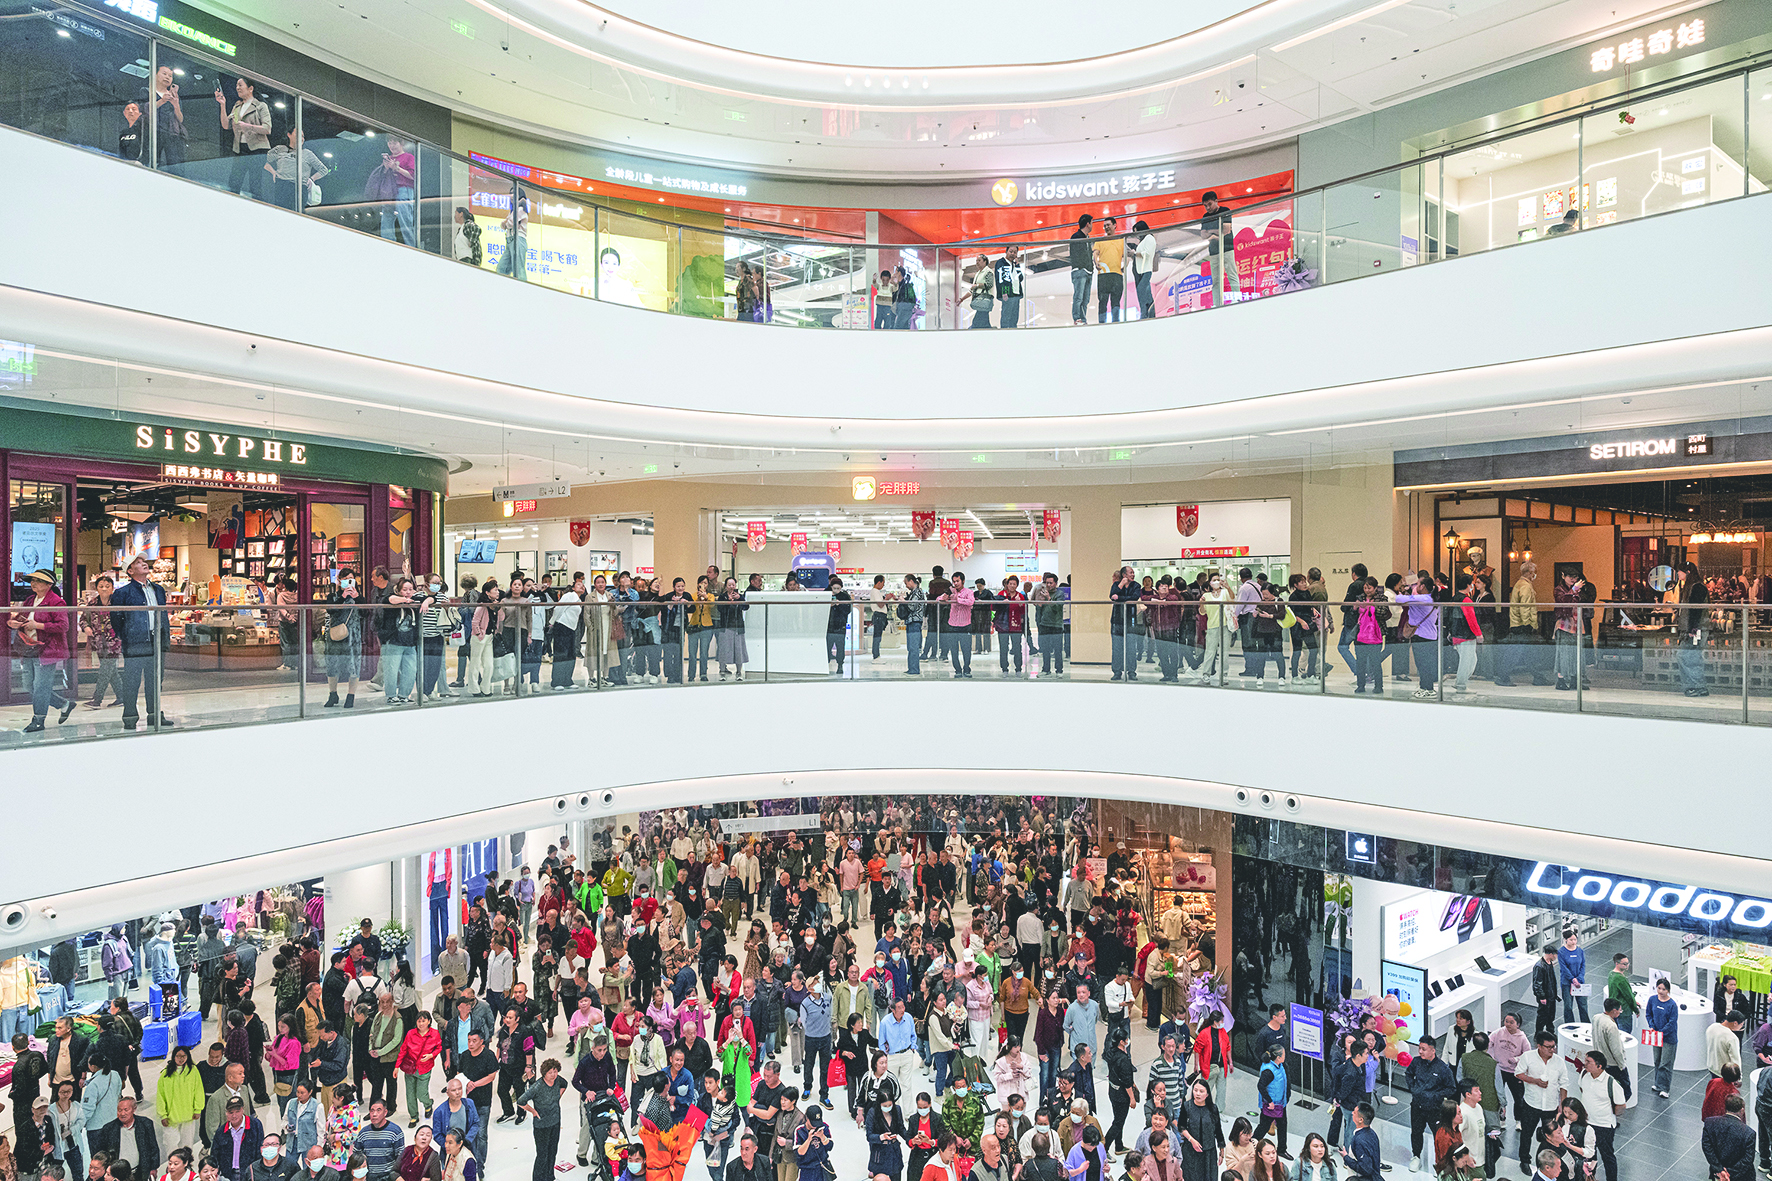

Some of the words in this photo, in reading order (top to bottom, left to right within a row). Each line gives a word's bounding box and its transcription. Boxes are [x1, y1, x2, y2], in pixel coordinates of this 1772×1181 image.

[1590, 19, 1705, 72] 奇哇奇娃
[605, 166, 748, 197] 全龄段儿童一站式购物及成长服务
[1026, 177, 1119, 200] kidswant
[1122, 170, 1176, 193] 孩子王
[1244, 238, 1269, 248] kidswant
[1688, 434, 1707, 444] 西町
[1590, 438, 1676, 460] SETIROM
[1688, 444, 1707, 454] 村屋
[164, 478, 196, 486] SISYPHE
[557, 485, 566, 496] L2
[1526, 861, 1772, 928] Coodoo
